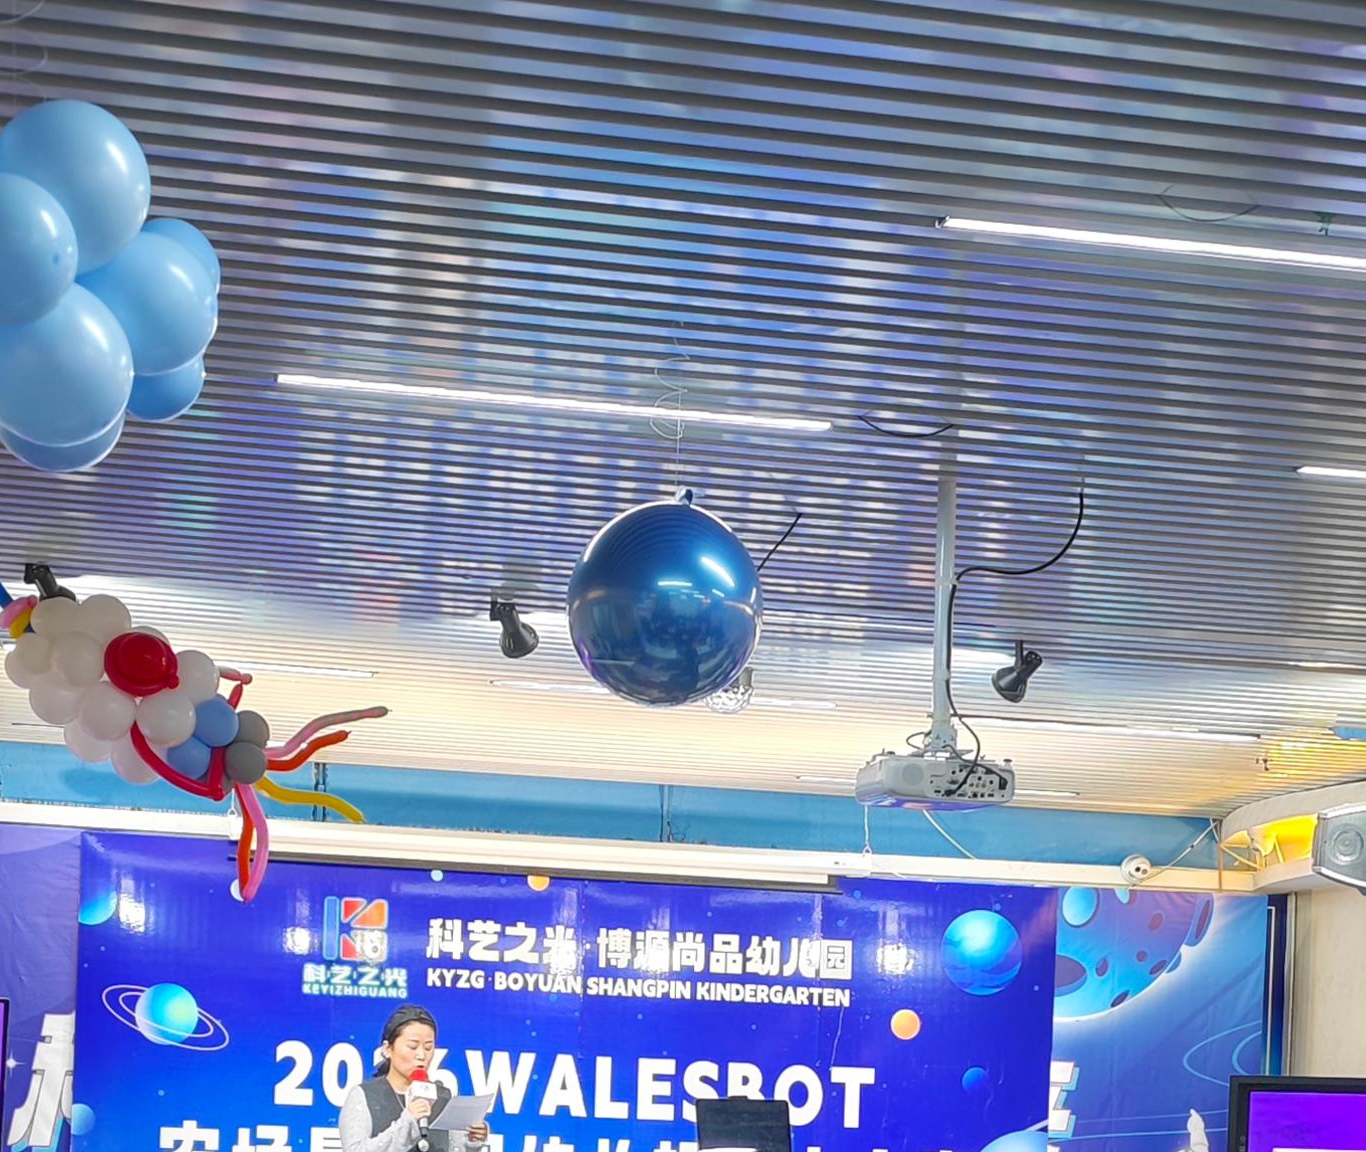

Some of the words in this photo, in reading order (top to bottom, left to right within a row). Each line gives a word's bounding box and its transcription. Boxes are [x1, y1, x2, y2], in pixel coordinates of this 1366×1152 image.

[302, 984, 408, 999] KEYIZHIGUANG
[586, 977, 692, 1000] SHANGPIN
[696, 982, 851, 1008] KINDERGARTEN
[273, 1040, 875, 1129] 206WALESBOT
